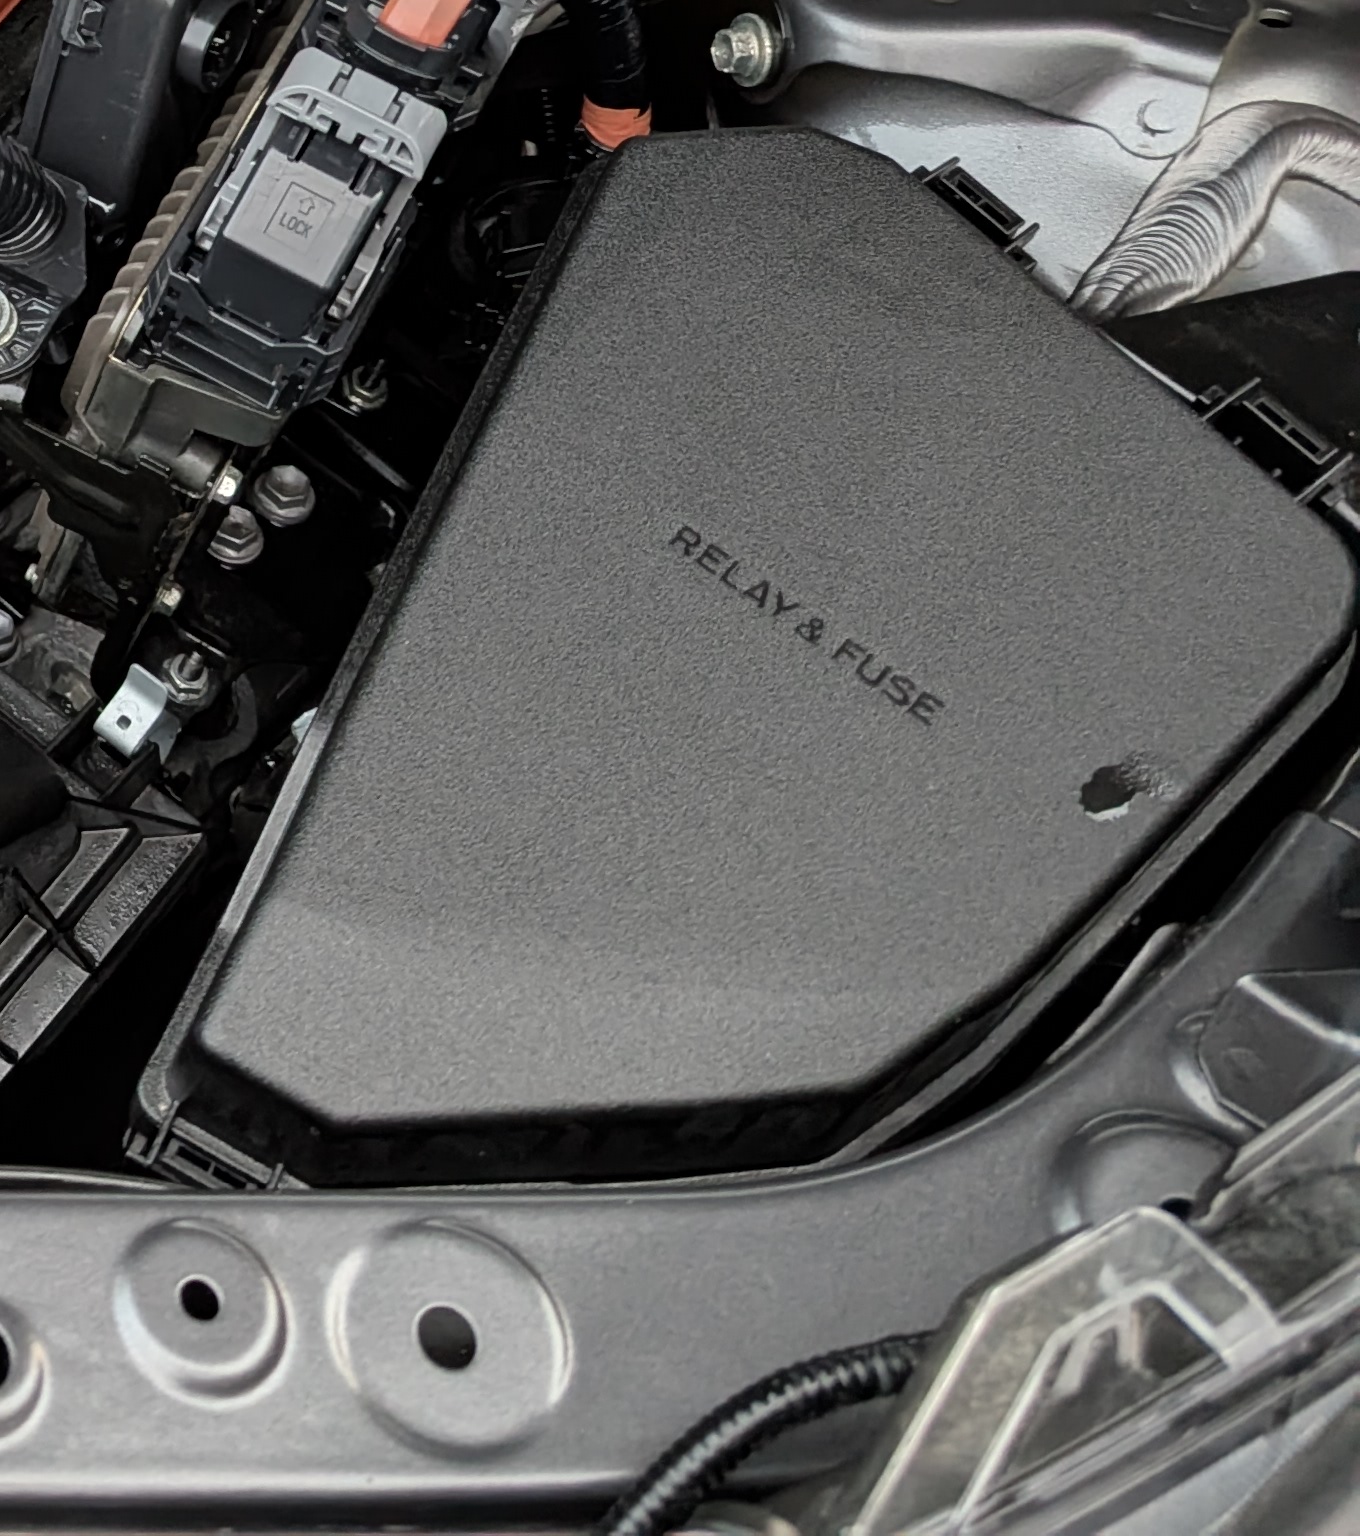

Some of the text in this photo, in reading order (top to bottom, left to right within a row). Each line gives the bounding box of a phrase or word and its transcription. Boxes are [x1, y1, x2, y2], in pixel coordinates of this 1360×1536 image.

[279, 212, 313, 238] LOCK
[669, 526, 945, 726] RELAY & FUSE
